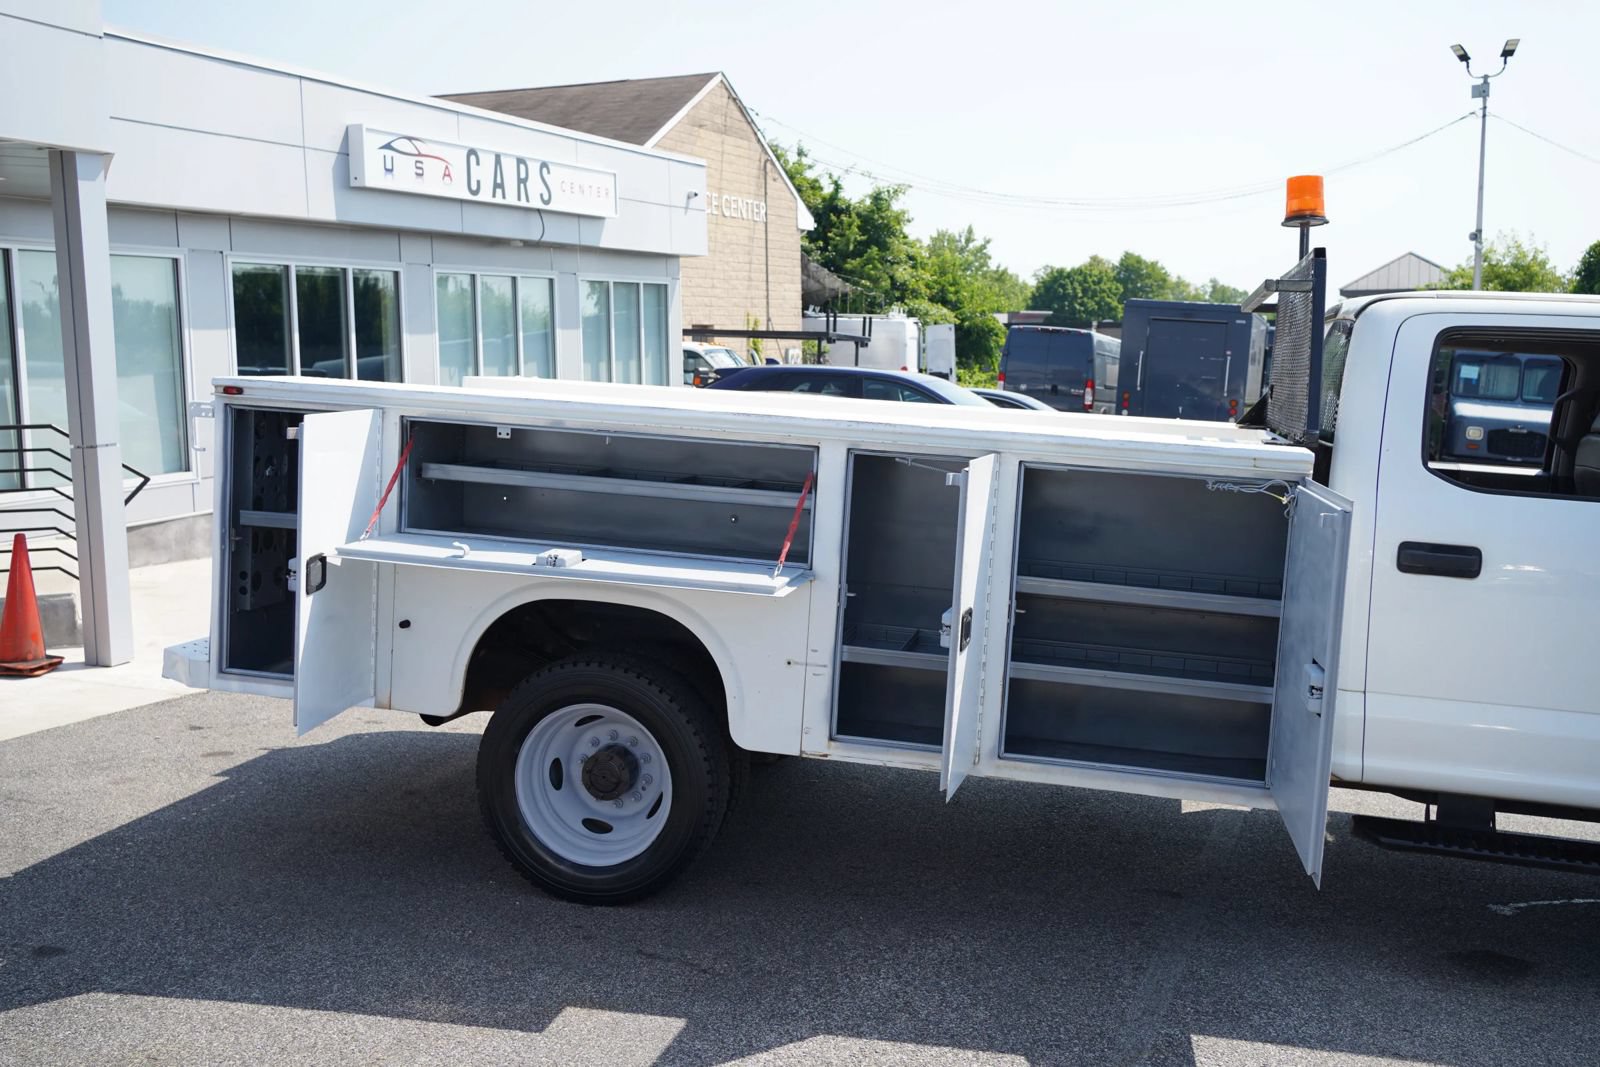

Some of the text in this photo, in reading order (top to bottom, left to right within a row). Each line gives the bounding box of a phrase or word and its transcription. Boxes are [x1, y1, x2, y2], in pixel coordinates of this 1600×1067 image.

[383, 147, 610, 206] USA CARS CENTER
[721, 195, 767, 223] CENTER
